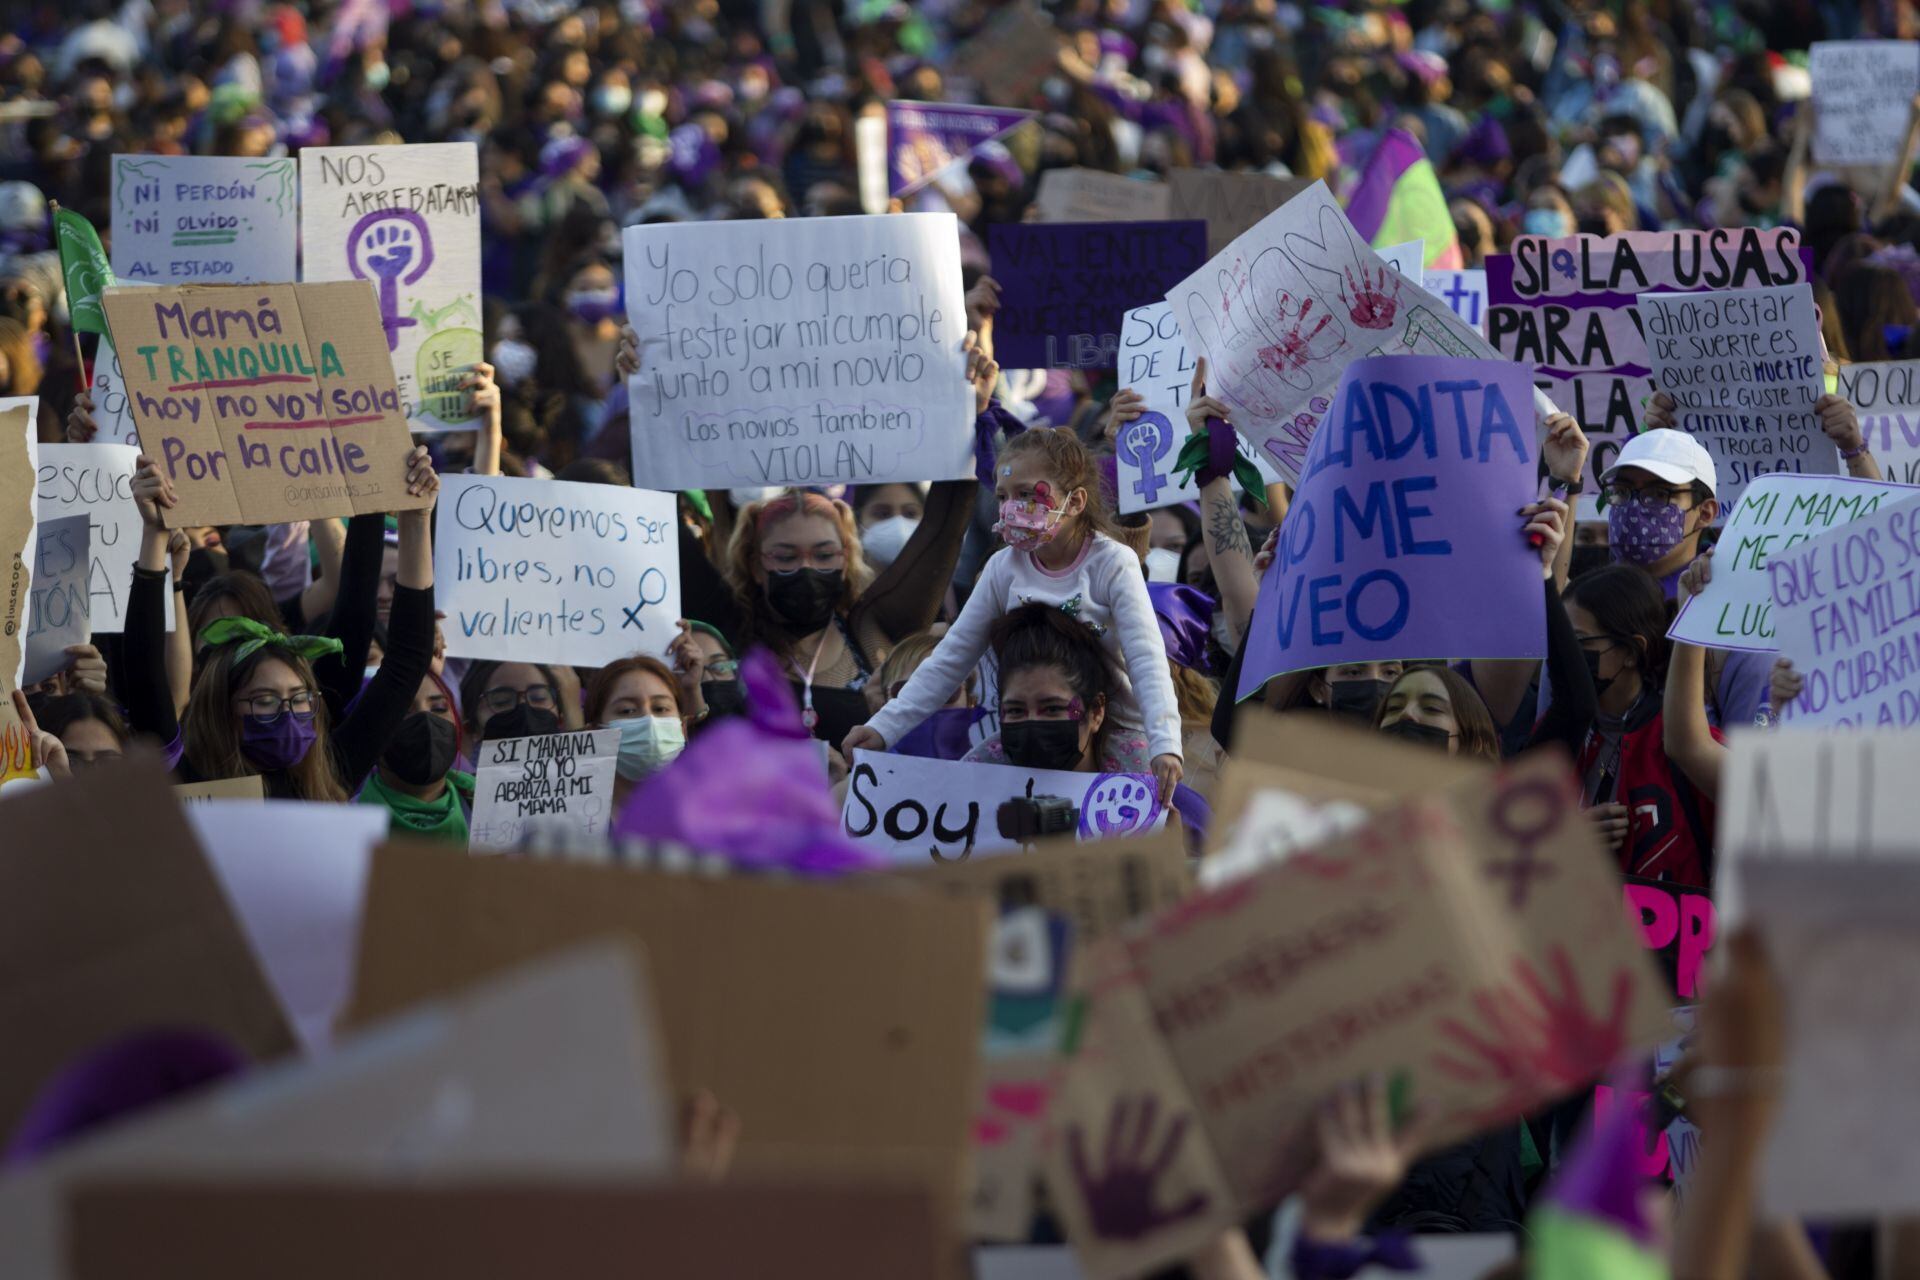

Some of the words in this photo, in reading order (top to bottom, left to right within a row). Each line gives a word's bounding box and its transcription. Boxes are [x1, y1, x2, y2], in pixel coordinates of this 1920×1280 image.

[176, 179, 256, 201] PERDÓN
[321, 153, 385, 186] NOS
[177, 212, 239, 231] OLVIDO
[128, 261, 159, 277] AL
[170, 261, 234, 276] ESTADO
[996, 227, 1199, 272] VALIENTES
[1513, 237, 1550, 296] SI
[1581, 237, 1650, 290] LA
[1673, 227, 1800, 290] USAS
[645, 242, 699, 306] Yo
[708, 243, 793, 306] solo
[154, 296, 282, 340] Mamá
[659, 304, 787, 372] festejar
[1488, 306, 1616, 367] PARA
[136, 341, 345, 383] TRANQUILA
[430, 350, 453, 370] SE
[1045, 333, 1119, 368] LIBR
[1128, 350, 1163, 384] DE
[136, 389, 200, 424] hoy
[217, 388, 258, 418] no
[265, 387, 323, 422] voy
[334, 382, 400, 416] sola
[652, 361, 730, 417] junto
[750, 366, 772, 393] a
[781, 356, 820, 390] mi
[834, 350, 924, 387] novio
[1669, 389, 1701, 410] NO
[1796, 384, 1819, 405] TU
[1840, 368, 1879, 408] YO
[686, 415, 720, 441] Los
[812, 403, 912, 434] tambien
[161, 436, 227, 482] Por
[237, 433, 272, 469] la
[279, 436, 371, 478] calle
[751, 440, 874, 482] VIOLAN
[1779, 434, 1810, 454] NO
[38, 465, 133, 505] escuc
[455, 484, 628, 542] Queremos
[636, 515, 670, 545] ser
[1334, 476, 1452, 564] ME
[1733, 491, 1780, 527] MI
[457, 547, 563, 585] libres,
[574, 563, 616, 589] no
[1767, 546, 1828, 608] QUE
[1832, 526, 1885, 590] LOS
[459, 597, 606, 638] valientes
[1276, 569, 1410, 650] VEO
[1810, 570, 1920, 657] FAMILI
[493, 738, 522, 764] SI
[526, 732, 596, 761] MAÑANA
[522, 759, 550, 782] SOY
[555, 756, 577, 778] YO
[494, 780, 551, 803] ABRAZA
[554, 778, 566, 798] A
[570, 775, 594, 796] MI
[845, 763, 980, 865] Soy
